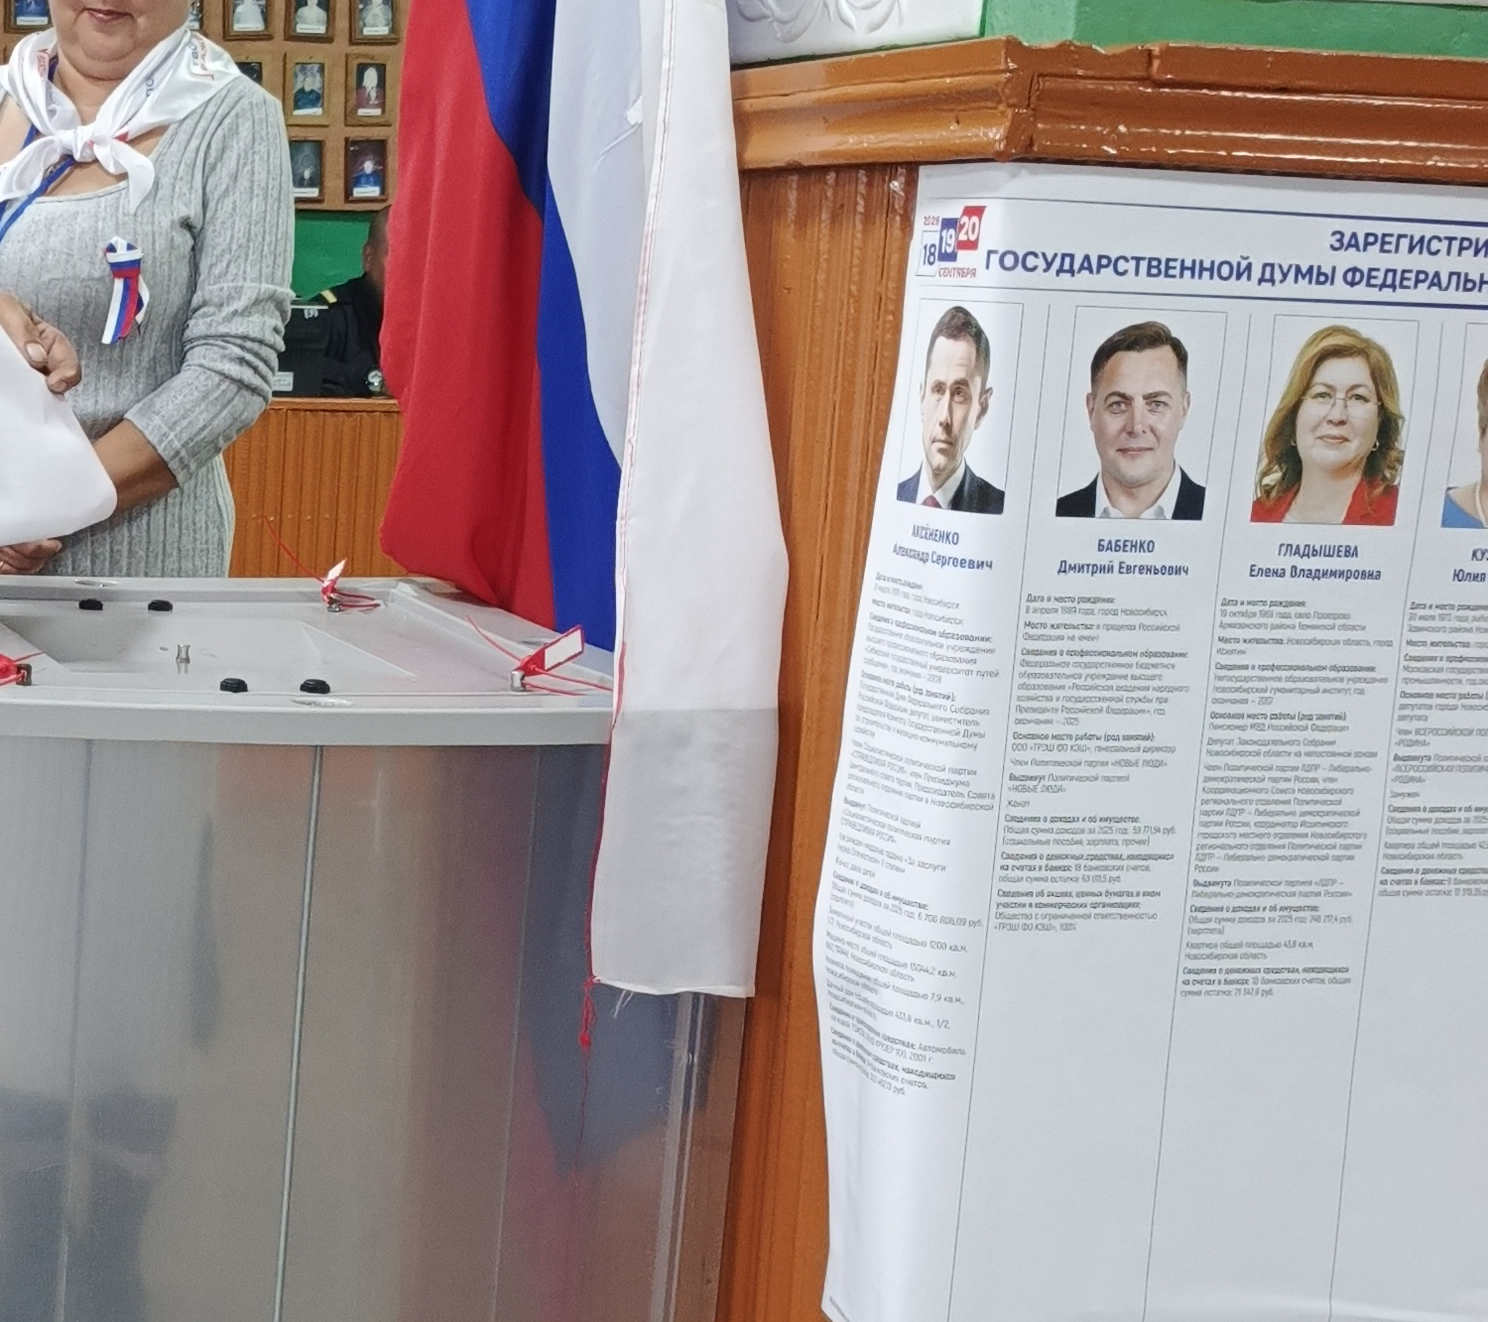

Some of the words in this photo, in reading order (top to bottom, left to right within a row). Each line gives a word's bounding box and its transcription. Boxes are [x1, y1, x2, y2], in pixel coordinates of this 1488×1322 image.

[958, 215, 979, 241] 20
[940, 228, 956, 253] 19
[923, 243, 937, 266] 18
[938, 267, 977, 278] СЕНТЯБРЯ
[985, 249, 1253, 282] ГОСУДАРСТВЕННОЙ
[1257, 262, 1337, 288] ДУМЫ
[1097, 539, 1156, 554] БАБЕНКО
[1278, 543, 1359, 559] ГЛАДЫШЕВА
[931, 550, 994, 570] Сергеевич
[1057, 560, 1114, 577] Дмитрий
[1118, 561, 1190, 577] Евгеньевич
[1249, 564, 1286, 579] Елена
[1290, 565, 1383, 582] Владимировна
[1452, 568, 1487, 582] Юлия
